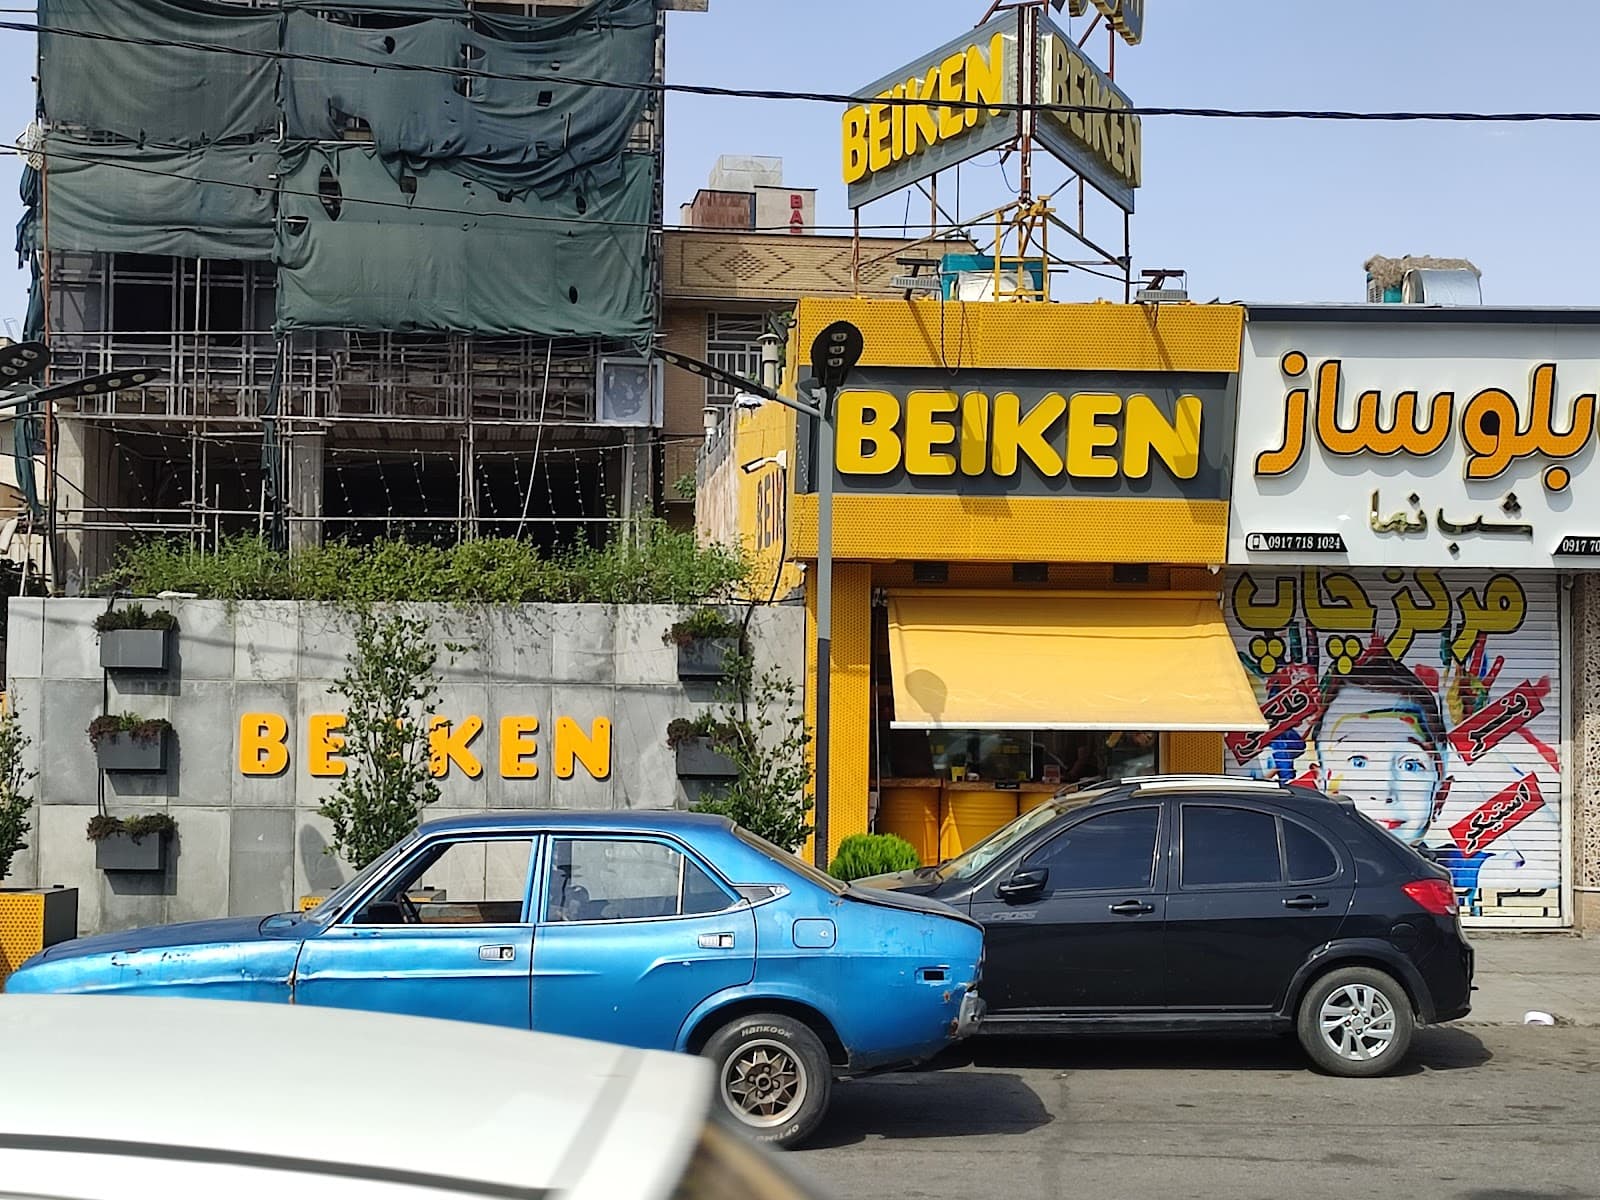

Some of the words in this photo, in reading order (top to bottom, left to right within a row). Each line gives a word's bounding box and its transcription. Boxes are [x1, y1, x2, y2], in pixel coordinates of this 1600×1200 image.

[842, 32, 1004, 184] BEIKEN
[1050, 33, 1141, 188] BEIKEN
[836, 390, 1202, 479] BEIKEN
[1255, 350, 1600, 492] بلوساز
[1268, 536, 1292, 549] 0917
[1295, 536, 1314, 549] 718
[1317, 536, 1340, 549] 1024
[1562, 539, 1586, 552] 0917
[1232, 566, 1377, 674] چاپ
[239, 712, 613, 779] BEKEN
[1469, 694, 1531, 758] بنر
[1466, 783, 1530, 854] استیکر
